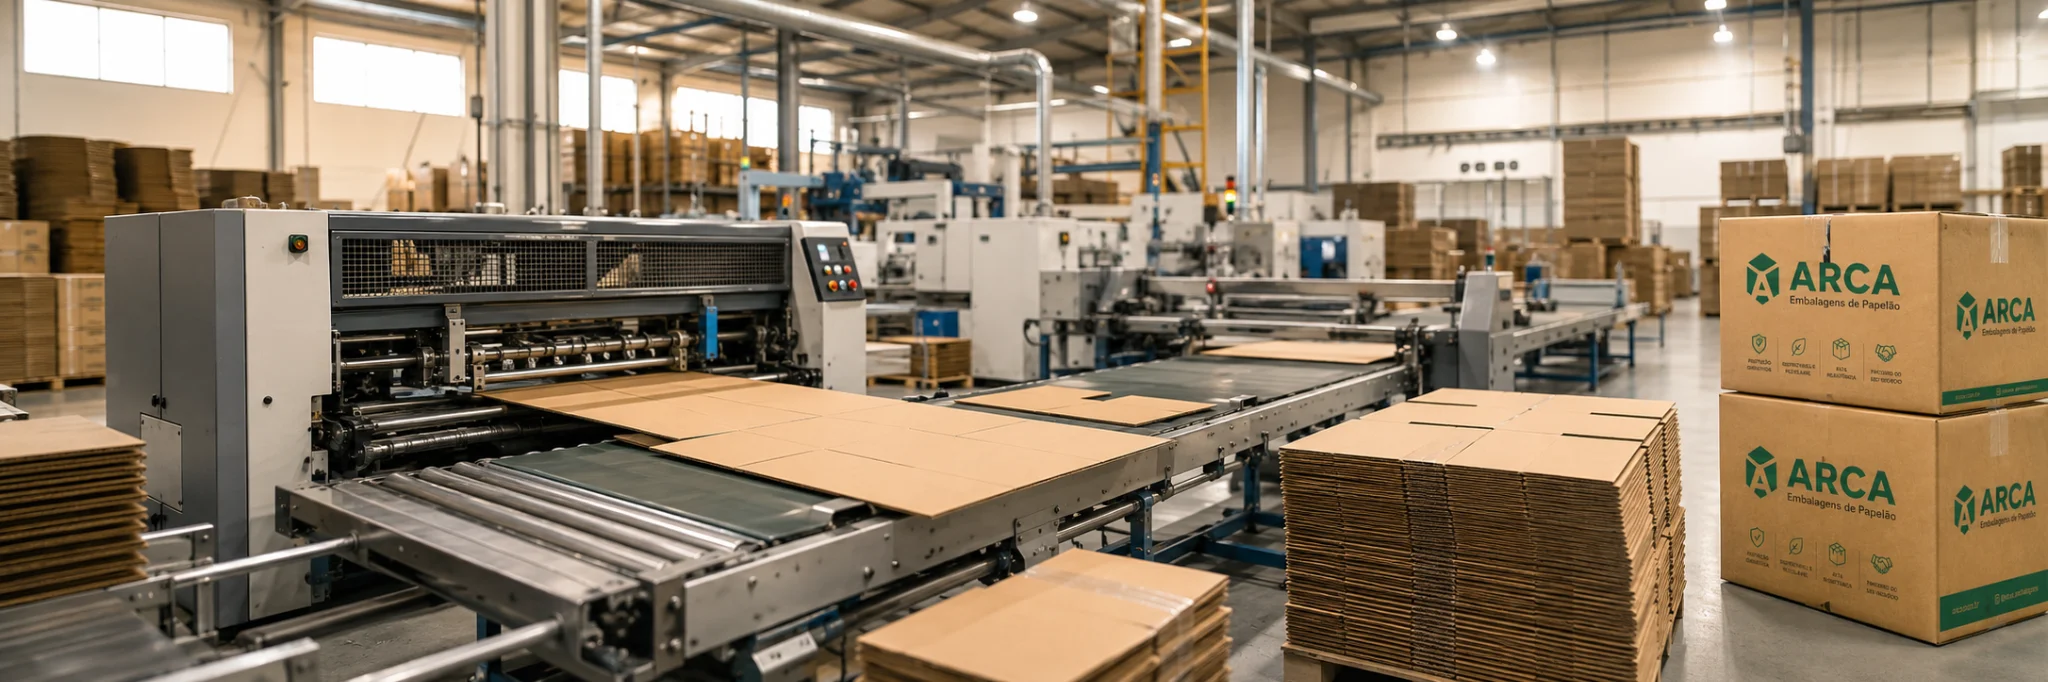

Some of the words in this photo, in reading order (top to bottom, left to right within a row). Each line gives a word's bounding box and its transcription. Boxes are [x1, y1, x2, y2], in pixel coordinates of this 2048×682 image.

[1789, 261, 1900, 296] ARCA
[1789, 295, 1845, 308] Embalagens
[1848, 300, 1860, 308] de
[1862, 300, 1900, 311] Papelão
[1982, 297, 2036, 324] ARCA
[1787, 458, 1896, 506] ARCA
[1787, 493, 1841, 509] Embalagens
[1844, 502, 1855, 513] de
[1858, 505, 1896, 520] Papelão
[1980, 480, 2036, 516] ARCA
